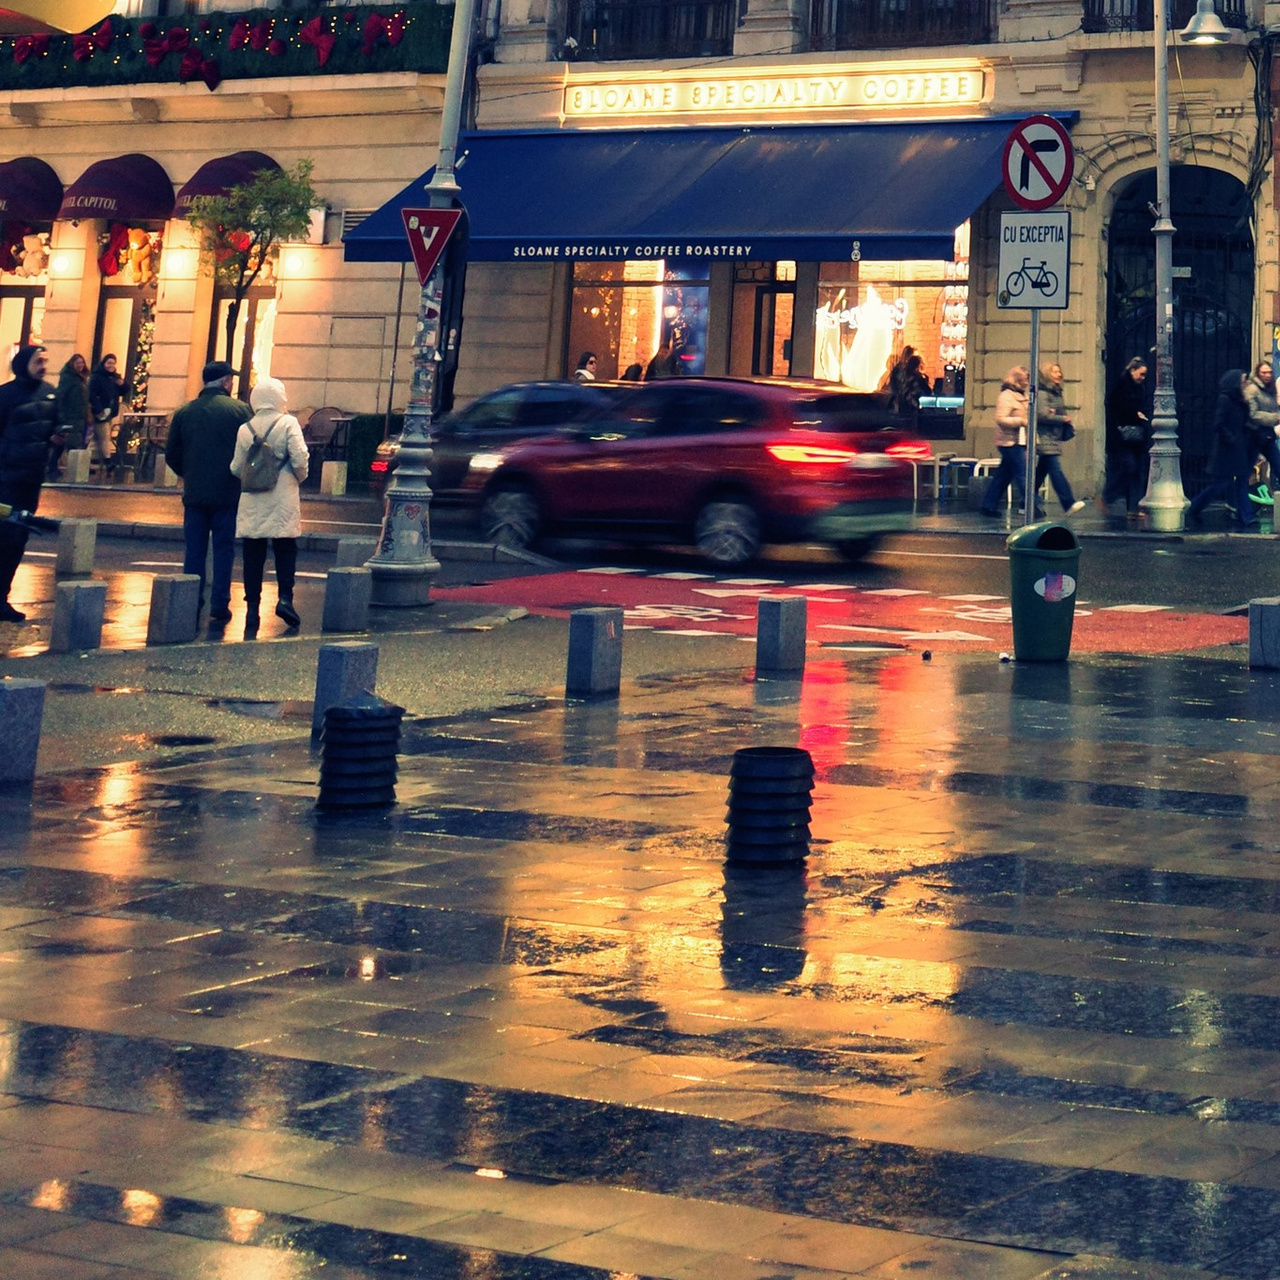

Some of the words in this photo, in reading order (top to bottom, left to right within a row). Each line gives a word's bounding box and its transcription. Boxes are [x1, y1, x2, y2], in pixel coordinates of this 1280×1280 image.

[574, 88, 672, 108] SLOANE
[692, 81, 843, 105] SPECIALTY
[863, 77, 967, 99] COFFEE
[77, 196, 118, 211] CAPITOL
[1004, 226, 1017, 243] CU
[514, 246, 560, 256] SLOANE
[565, 246, 629, 256] SPECIALTY
[635, 246, 680, 256] COFFEE
[686, 245, 752, 256] ROASTERY
